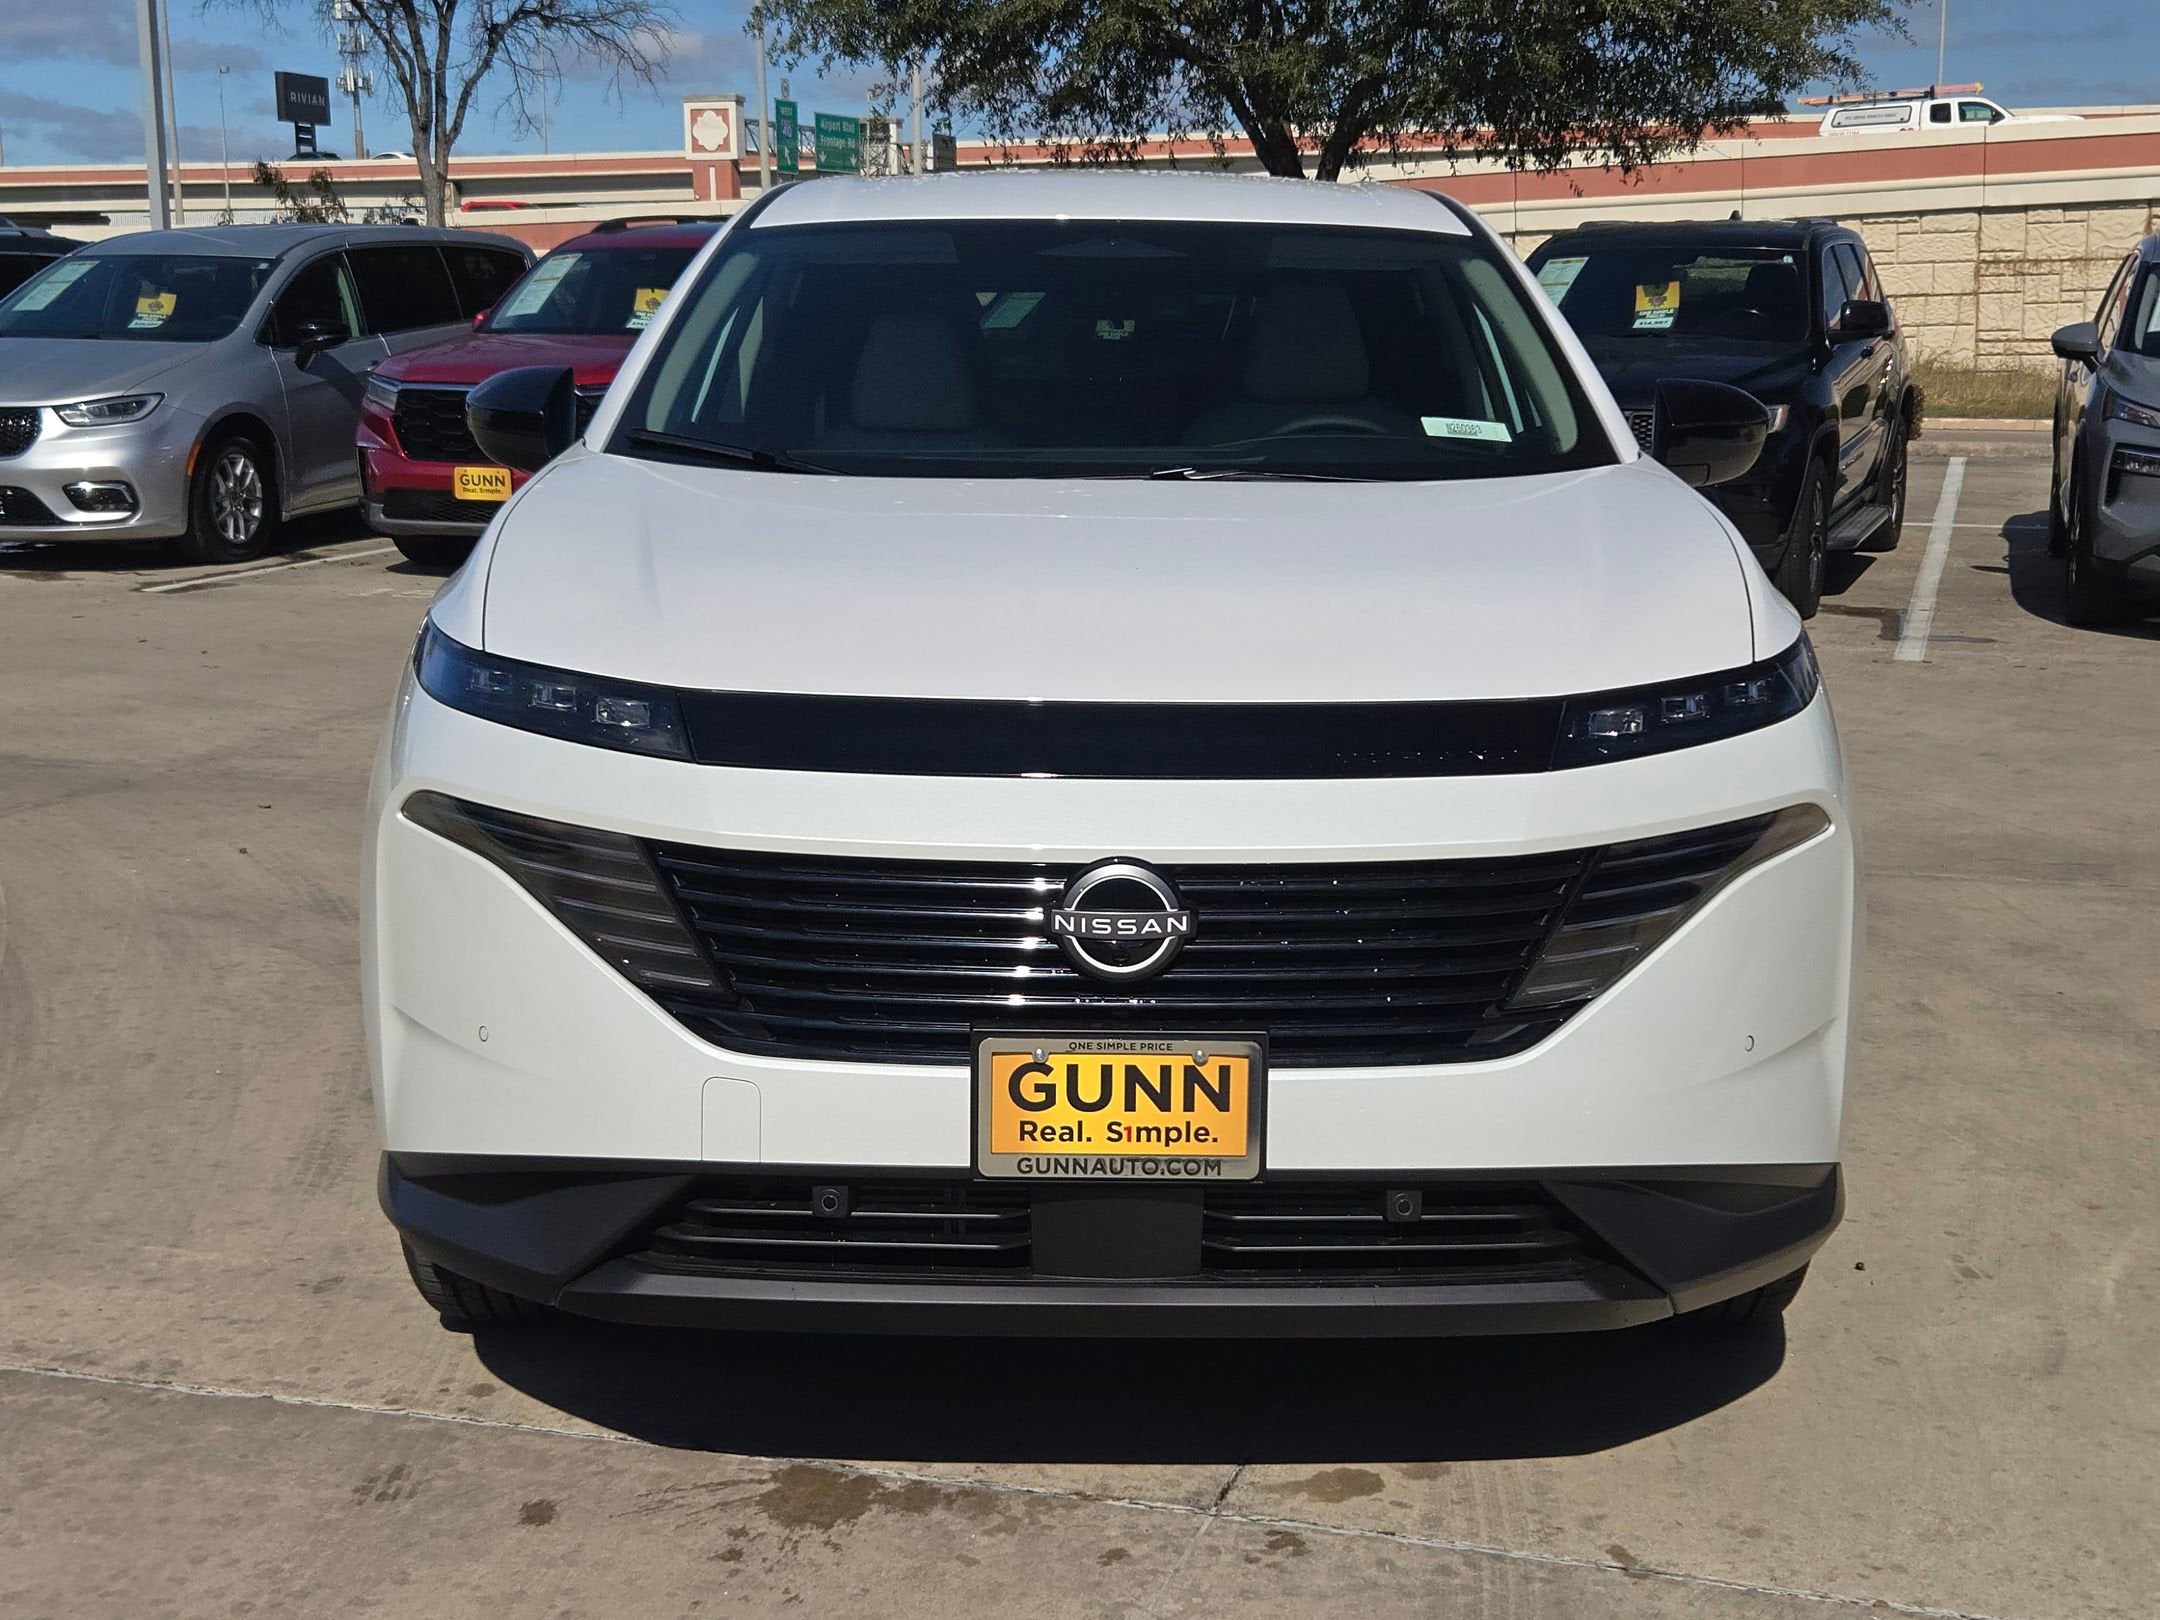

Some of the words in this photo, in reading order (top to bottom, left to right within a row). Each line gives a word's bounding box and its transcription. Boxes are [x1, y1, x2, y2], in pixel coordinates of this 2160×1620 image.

[290, 91, 325, 107] RIVIAN
[820, 118, 841, 132] Airport
[842, 121, 855, 133] Blvd
[847, 138, 856, 148] Rd
[460, 474, 506, 487] GUNN
[1054, 914, 1187, 935] NISSAN
[1068, 1041, 1093, 1051] ONE
[1096, 1042, 1136, 1051] SIMPLE
[1140, 1042, 1173, 1051] PRICE
[1008, 1062, 1231, 1113] GUNN
[1019, 1120, 1092, 1143] Real.
[1106, 1120, 1218, 1147] S1mple.
[1017, 1157, 1222, 1176] GUNNAUTO.COM
